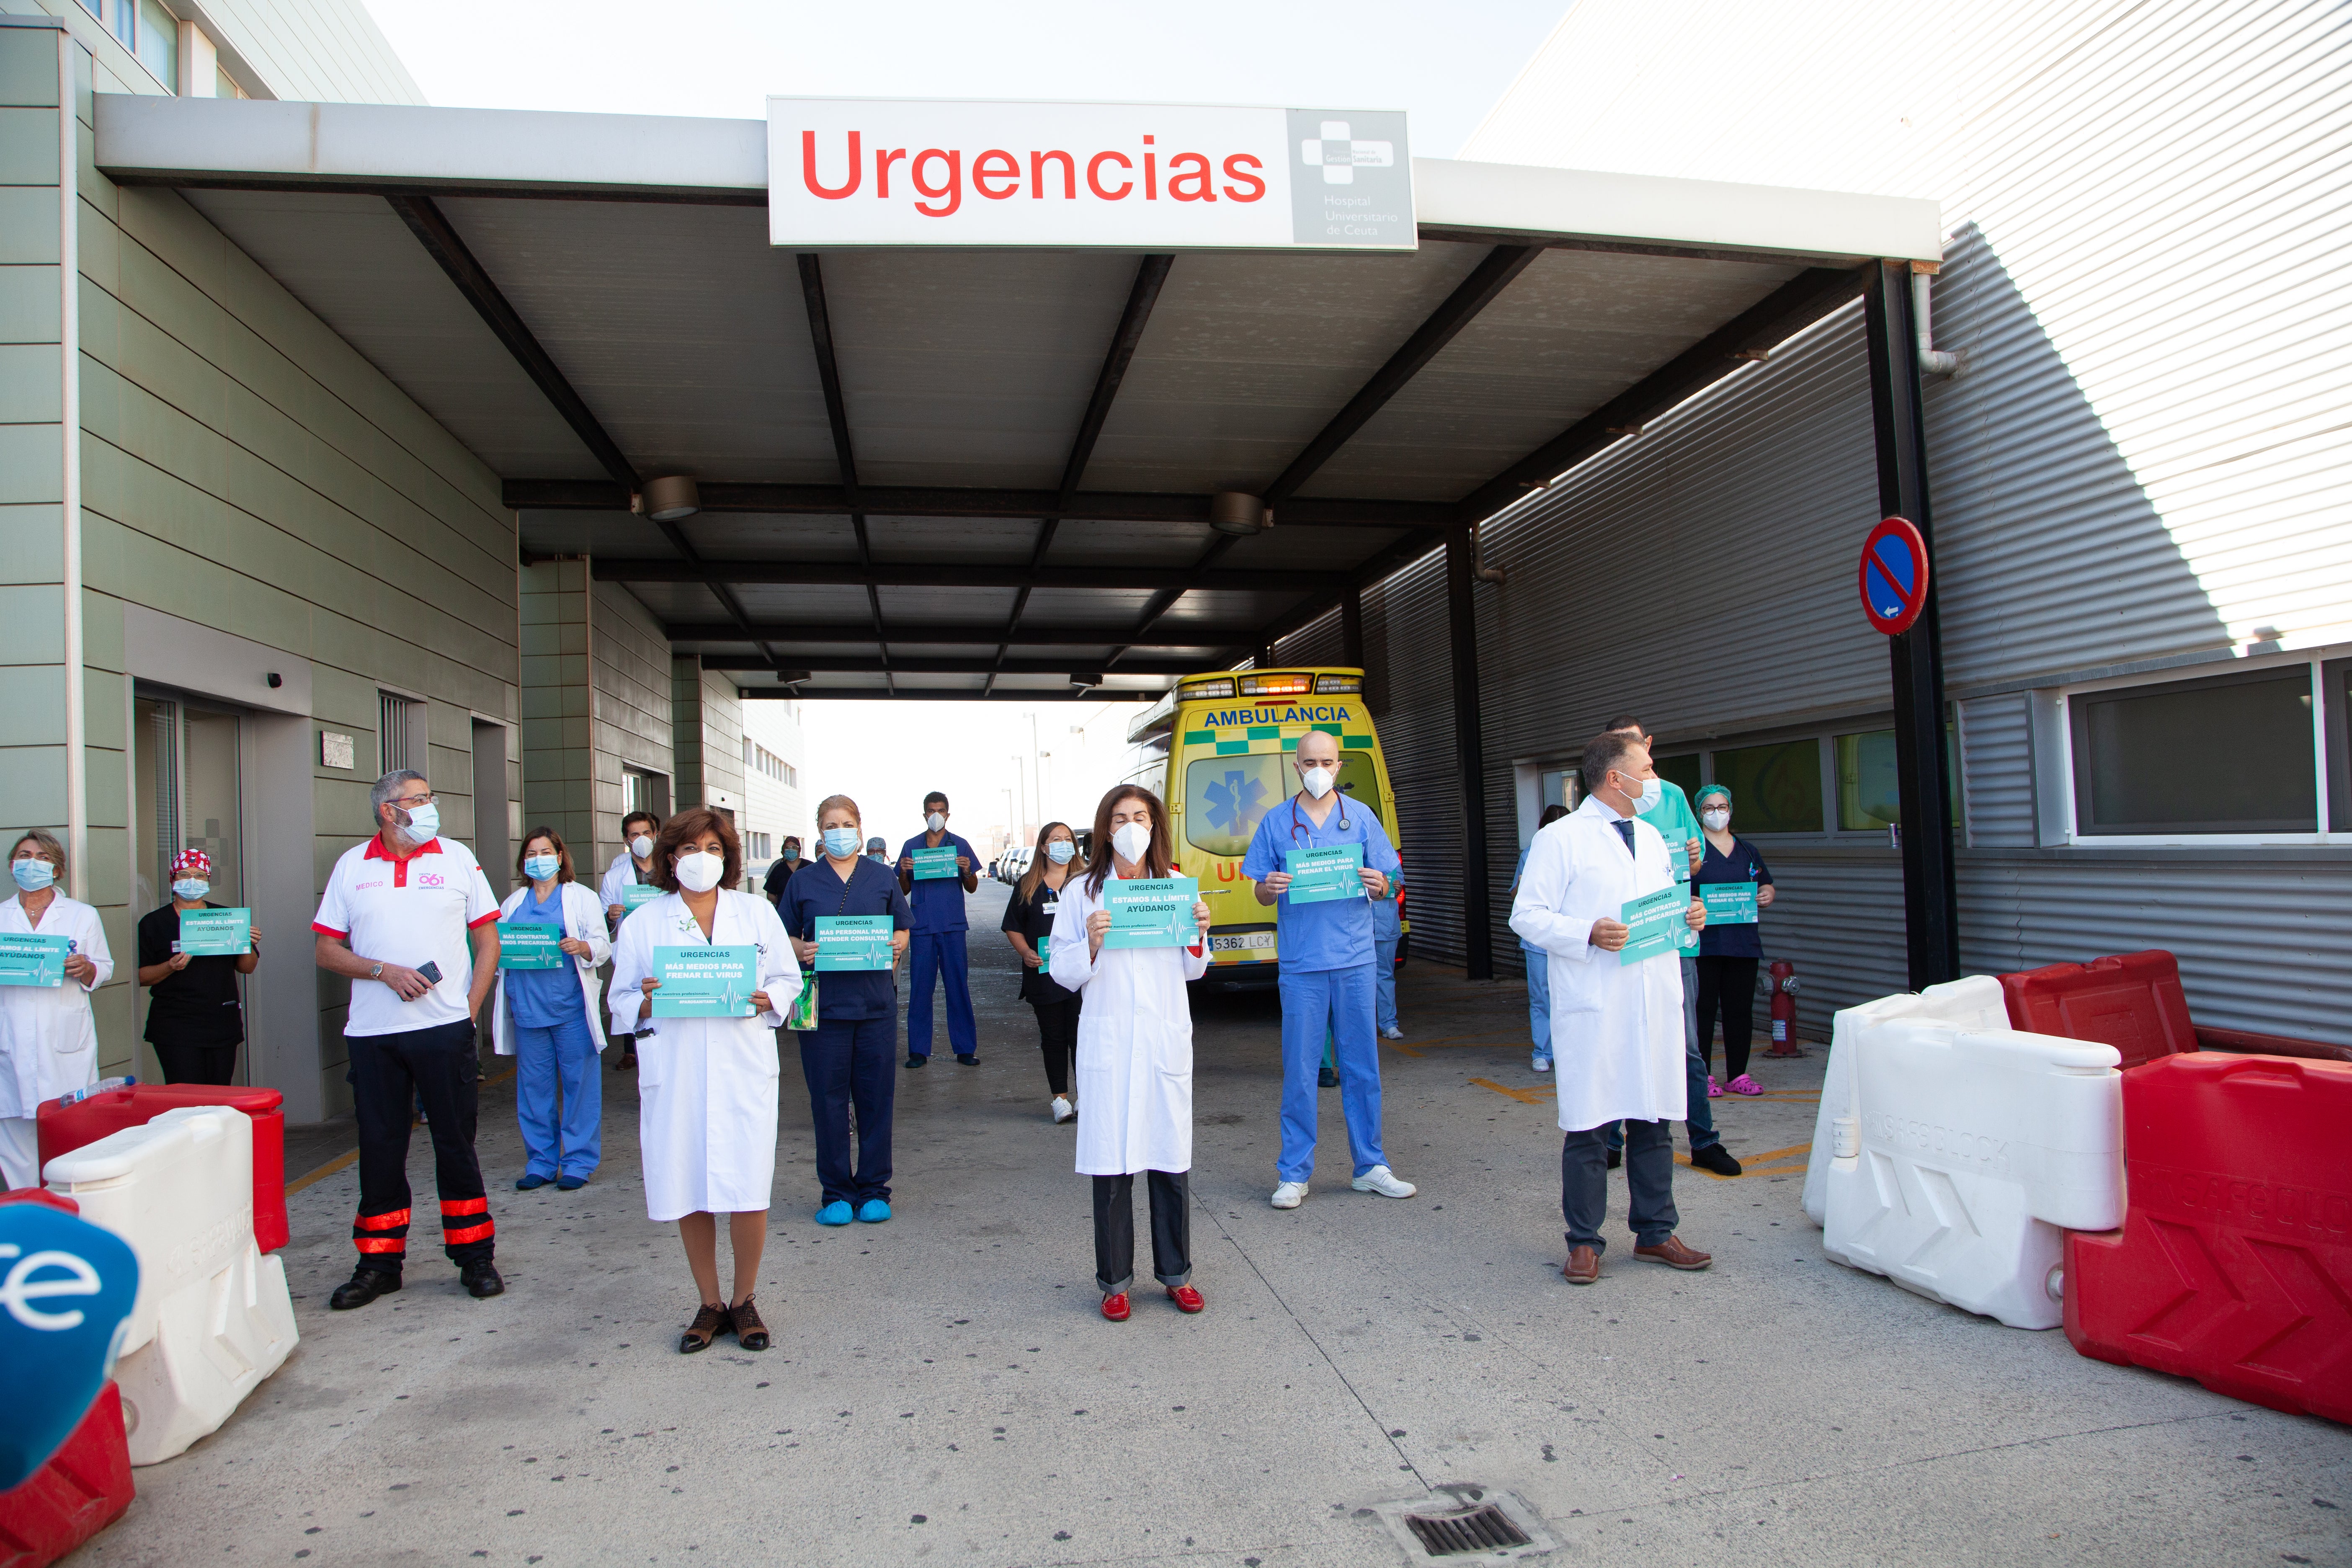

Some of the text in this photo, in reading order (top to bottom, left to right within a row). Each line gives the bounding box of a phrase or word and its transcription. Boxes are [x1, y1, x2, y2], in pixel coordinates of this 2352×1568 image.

[802, 130, 1266, 217] Urgencias
[1325, 195, 1370, 208] Hospital
[1326, 211, 1398, 222] Universitario
[1327, 224, 1377, 235] de Ceuta
[1204, 707, 1351, 727] AMBULANCIA
[356, 881, 383, 891] MEDICO
[419, 874, 444, 886] 061
[1638, 892, 1672, 908] URGENCIAS
[1127, 904, 1176, 913] AYÚDANOS
[1630, 900, 1681, 921] MÁS CONTRATOS
[1627, 906, 1688, 930] ENOS PRECARIEDAD
[1215, 935, 1271, 949] 5362 LCY
